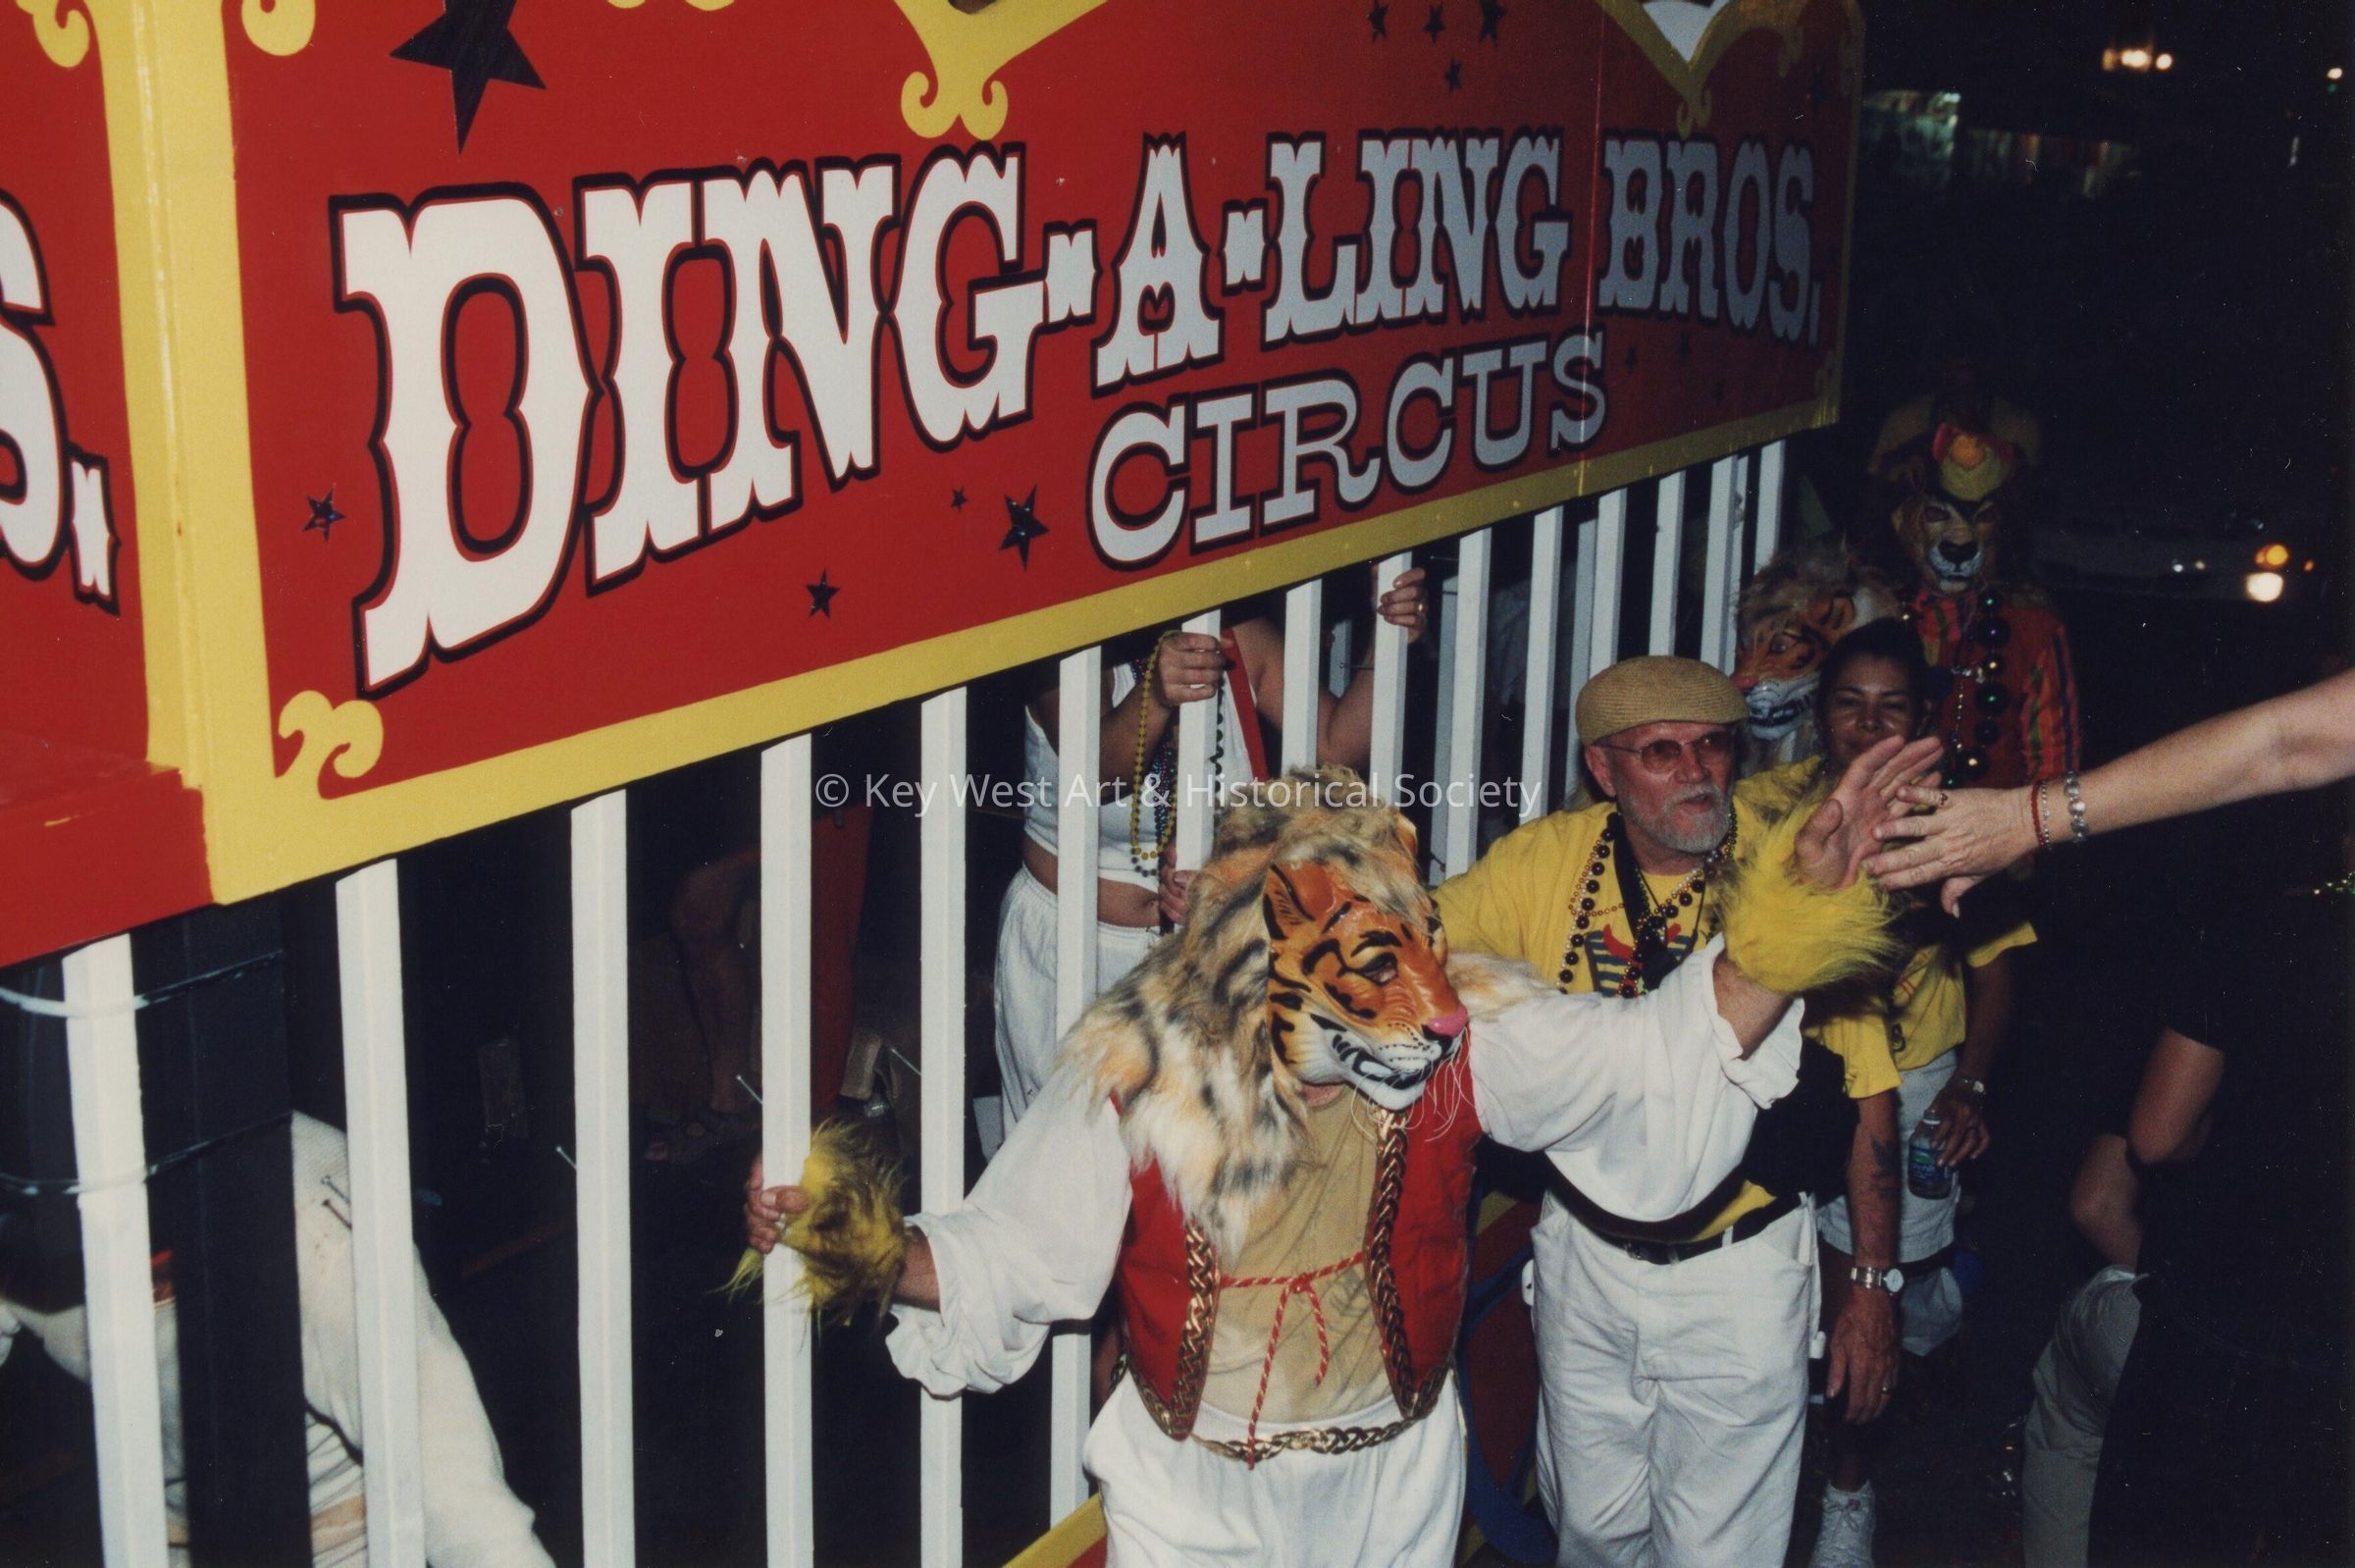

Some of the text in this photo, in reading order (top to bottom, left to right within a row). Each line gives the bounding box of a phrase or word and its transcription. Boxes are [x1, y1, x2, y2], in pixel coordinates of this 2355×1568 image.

[335, 131, 1824, 692] DING-A-LING BROS.
[1088, 328, 1607, 566] CIRCUS
